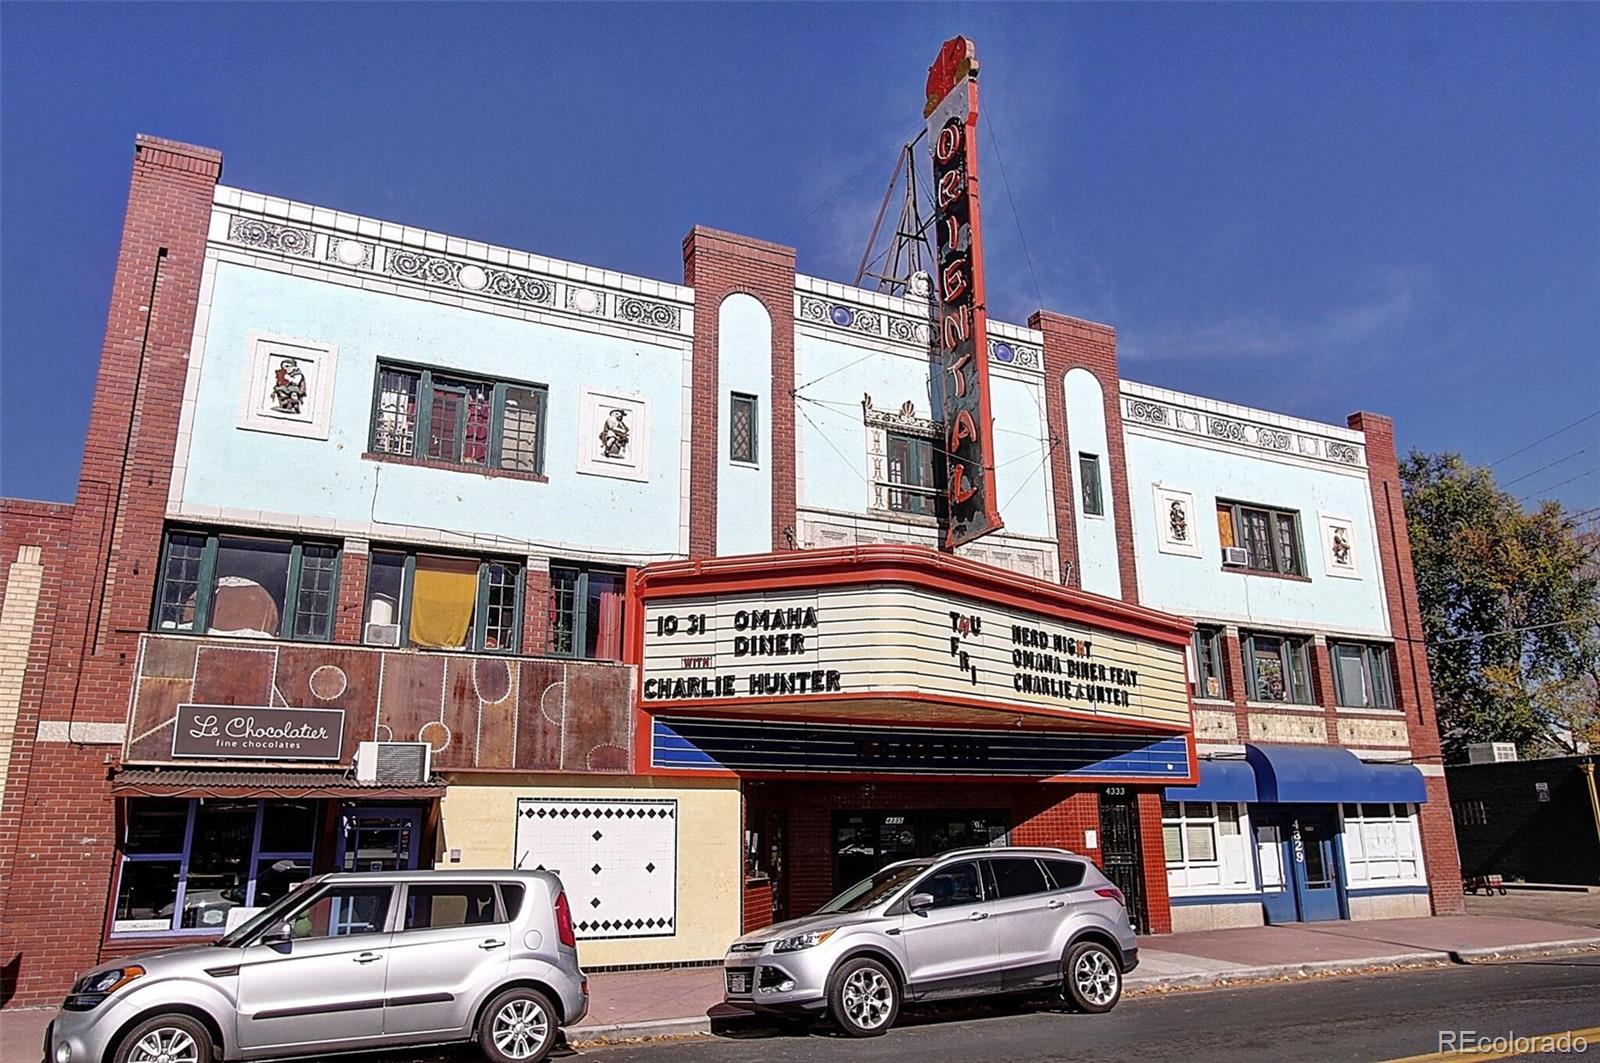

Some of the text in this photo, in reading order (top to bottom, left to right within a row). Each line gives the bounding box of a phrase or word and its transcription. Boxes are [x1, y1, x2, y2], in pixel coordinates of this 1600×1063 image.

[937, 123, 978, 504] ORIENTAL
[657, 614, 706, 637] 10 31
[734, 606, 818, 632] OMAHA
[734, 633, 805, 657] DINER
[1012, 624, 1092, 659] NERD NIGHT
[682, 656, 712, 669] WITH
[1012, 648, 1138, 688] OMAHA DINER FEAT
[644, 669, 841, 699] CHARLIE HUNTER
[1013, 672, 1072, 701] CHARLIE
[189, 715, 329, 739] Le Chocolatier
[216, 739, 301, 749] fine chocolates
[1105, 786, 1125, 796] 4333
[1292, 819, 1304, 863] 4329
